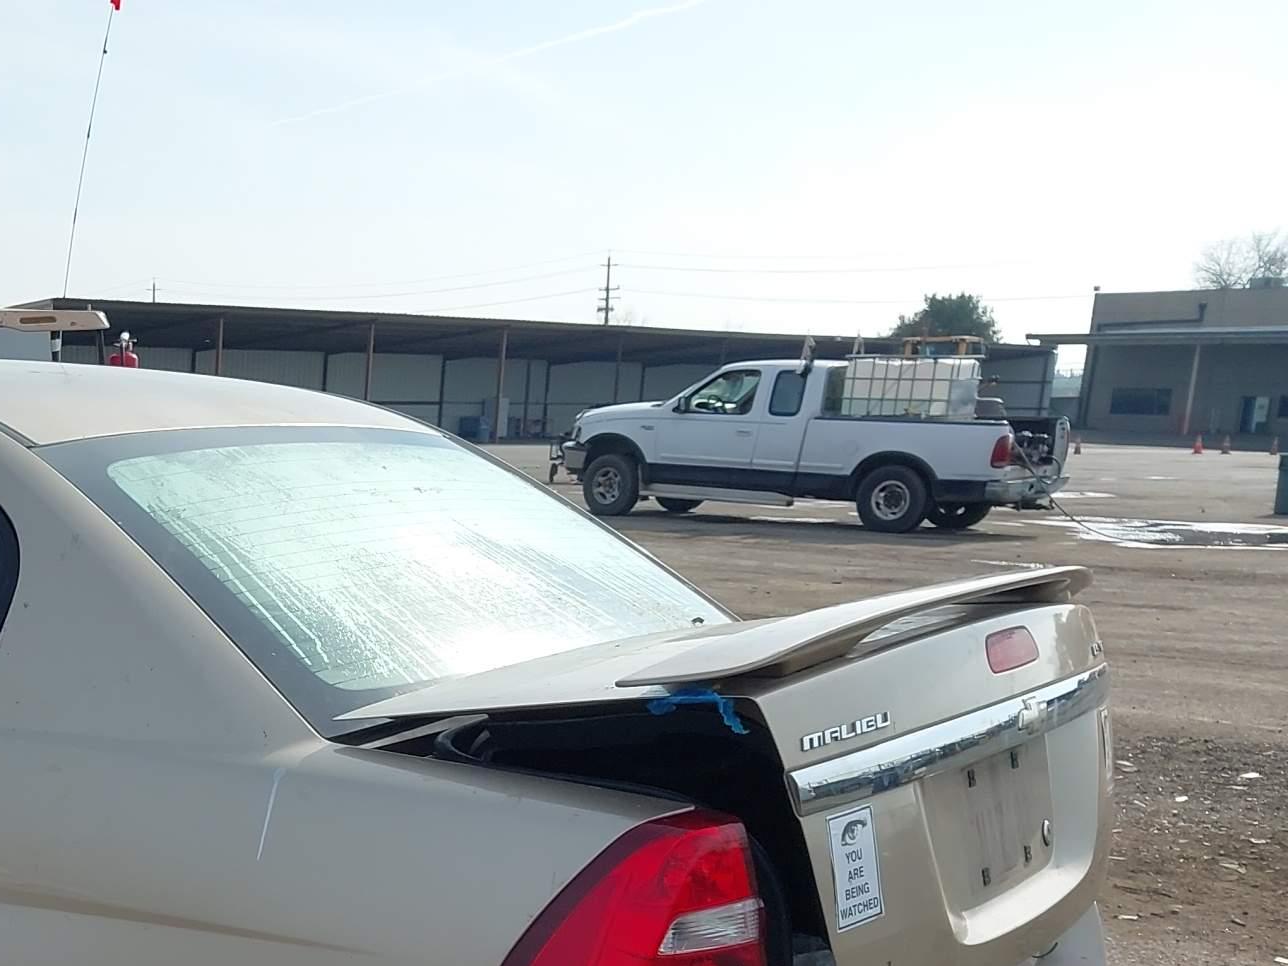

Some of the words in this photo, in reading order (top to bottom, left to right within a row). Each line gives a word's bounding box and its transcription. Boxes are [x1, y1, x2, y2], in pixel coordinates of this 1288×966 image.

[801, 711, 891, 752] MALIBU
[845, 848, 863, 864] YOU
[847, 866, 865, 882] ARE
[845, 882, 870, 901] BEING
[840, 896, 879, 921] WATCHED
